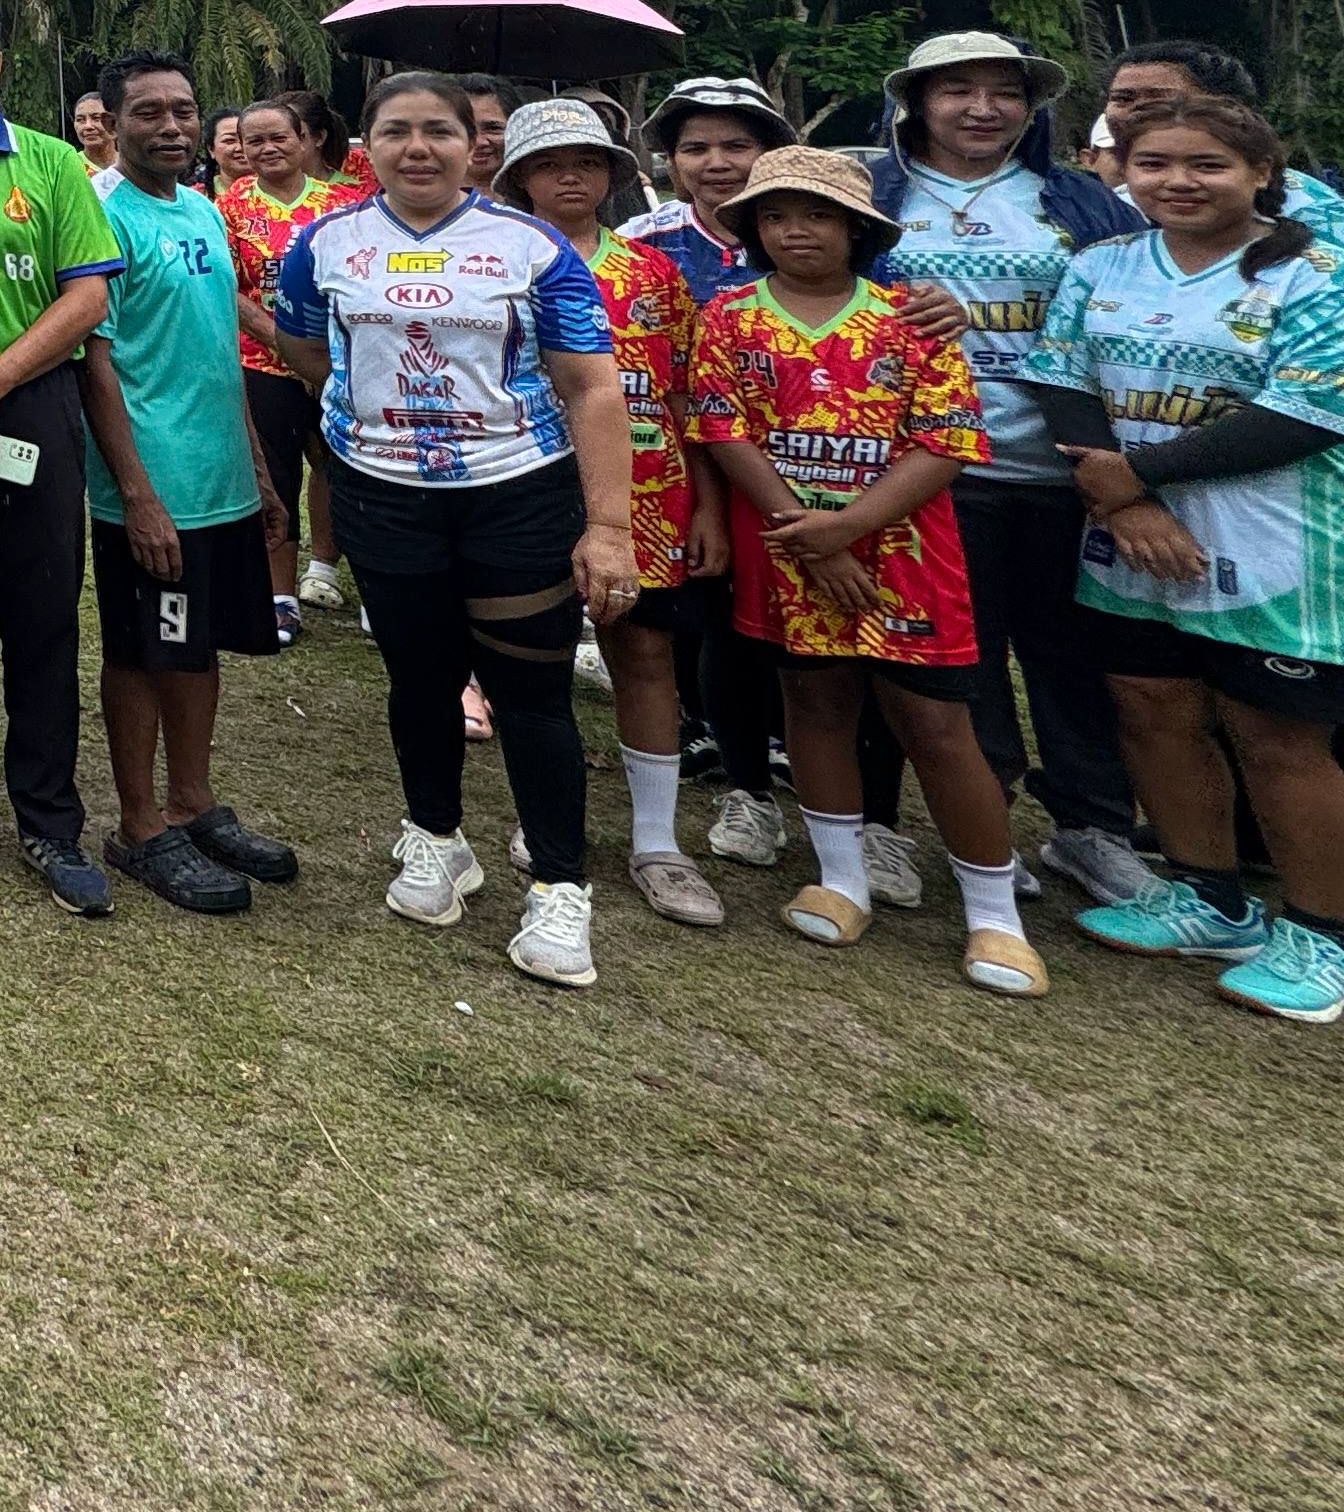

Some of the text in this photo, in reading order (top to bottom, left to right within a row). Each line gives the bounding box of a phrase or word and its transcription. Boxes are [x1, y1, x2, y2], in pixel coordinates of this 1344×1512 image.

[4, 252, 35, 282] 68
[387, 250, 448, 273] NOS
[458, 265, 509, 278] Red Bull
[396, 287, 442, 304] KIA
[431, 316, 503, 331] KENWOOD
[395, 372, 462, 400] DAKAR
[159, 591, 188, 643] 9
